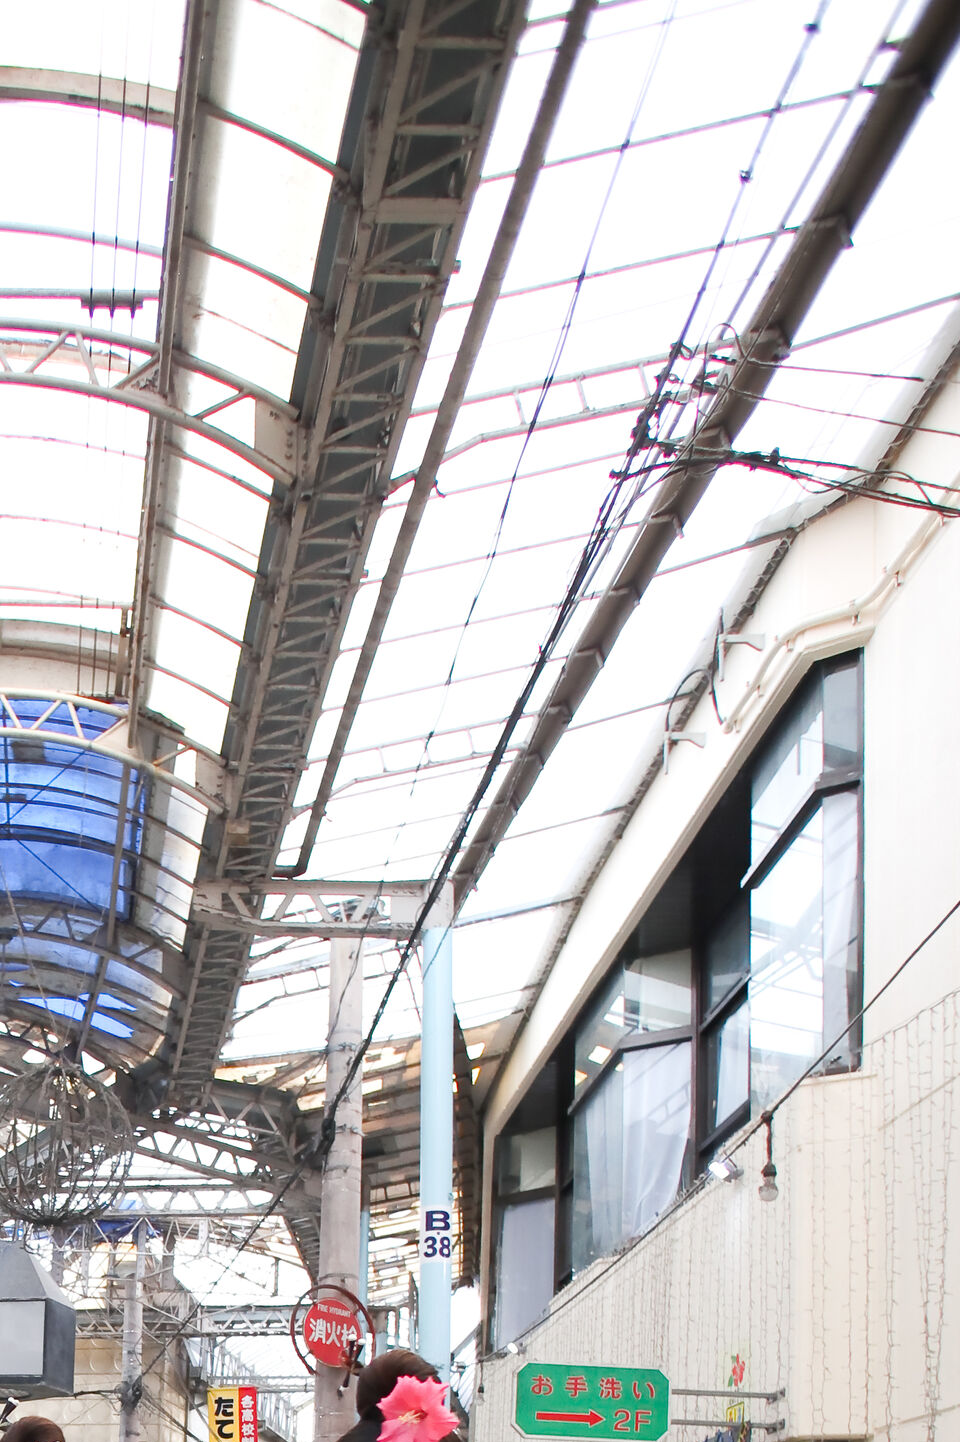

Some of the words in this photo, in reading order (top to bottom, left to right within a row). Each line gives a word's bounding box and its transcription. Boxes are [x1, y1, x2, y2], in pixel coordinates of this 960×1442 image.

[425, 1210, 451, 1232] B
[423, 1236, 451, 1258] 38
[530, 1374, 656, 1400] お手洗い
[612, 1408, 653, 1433] 2F
